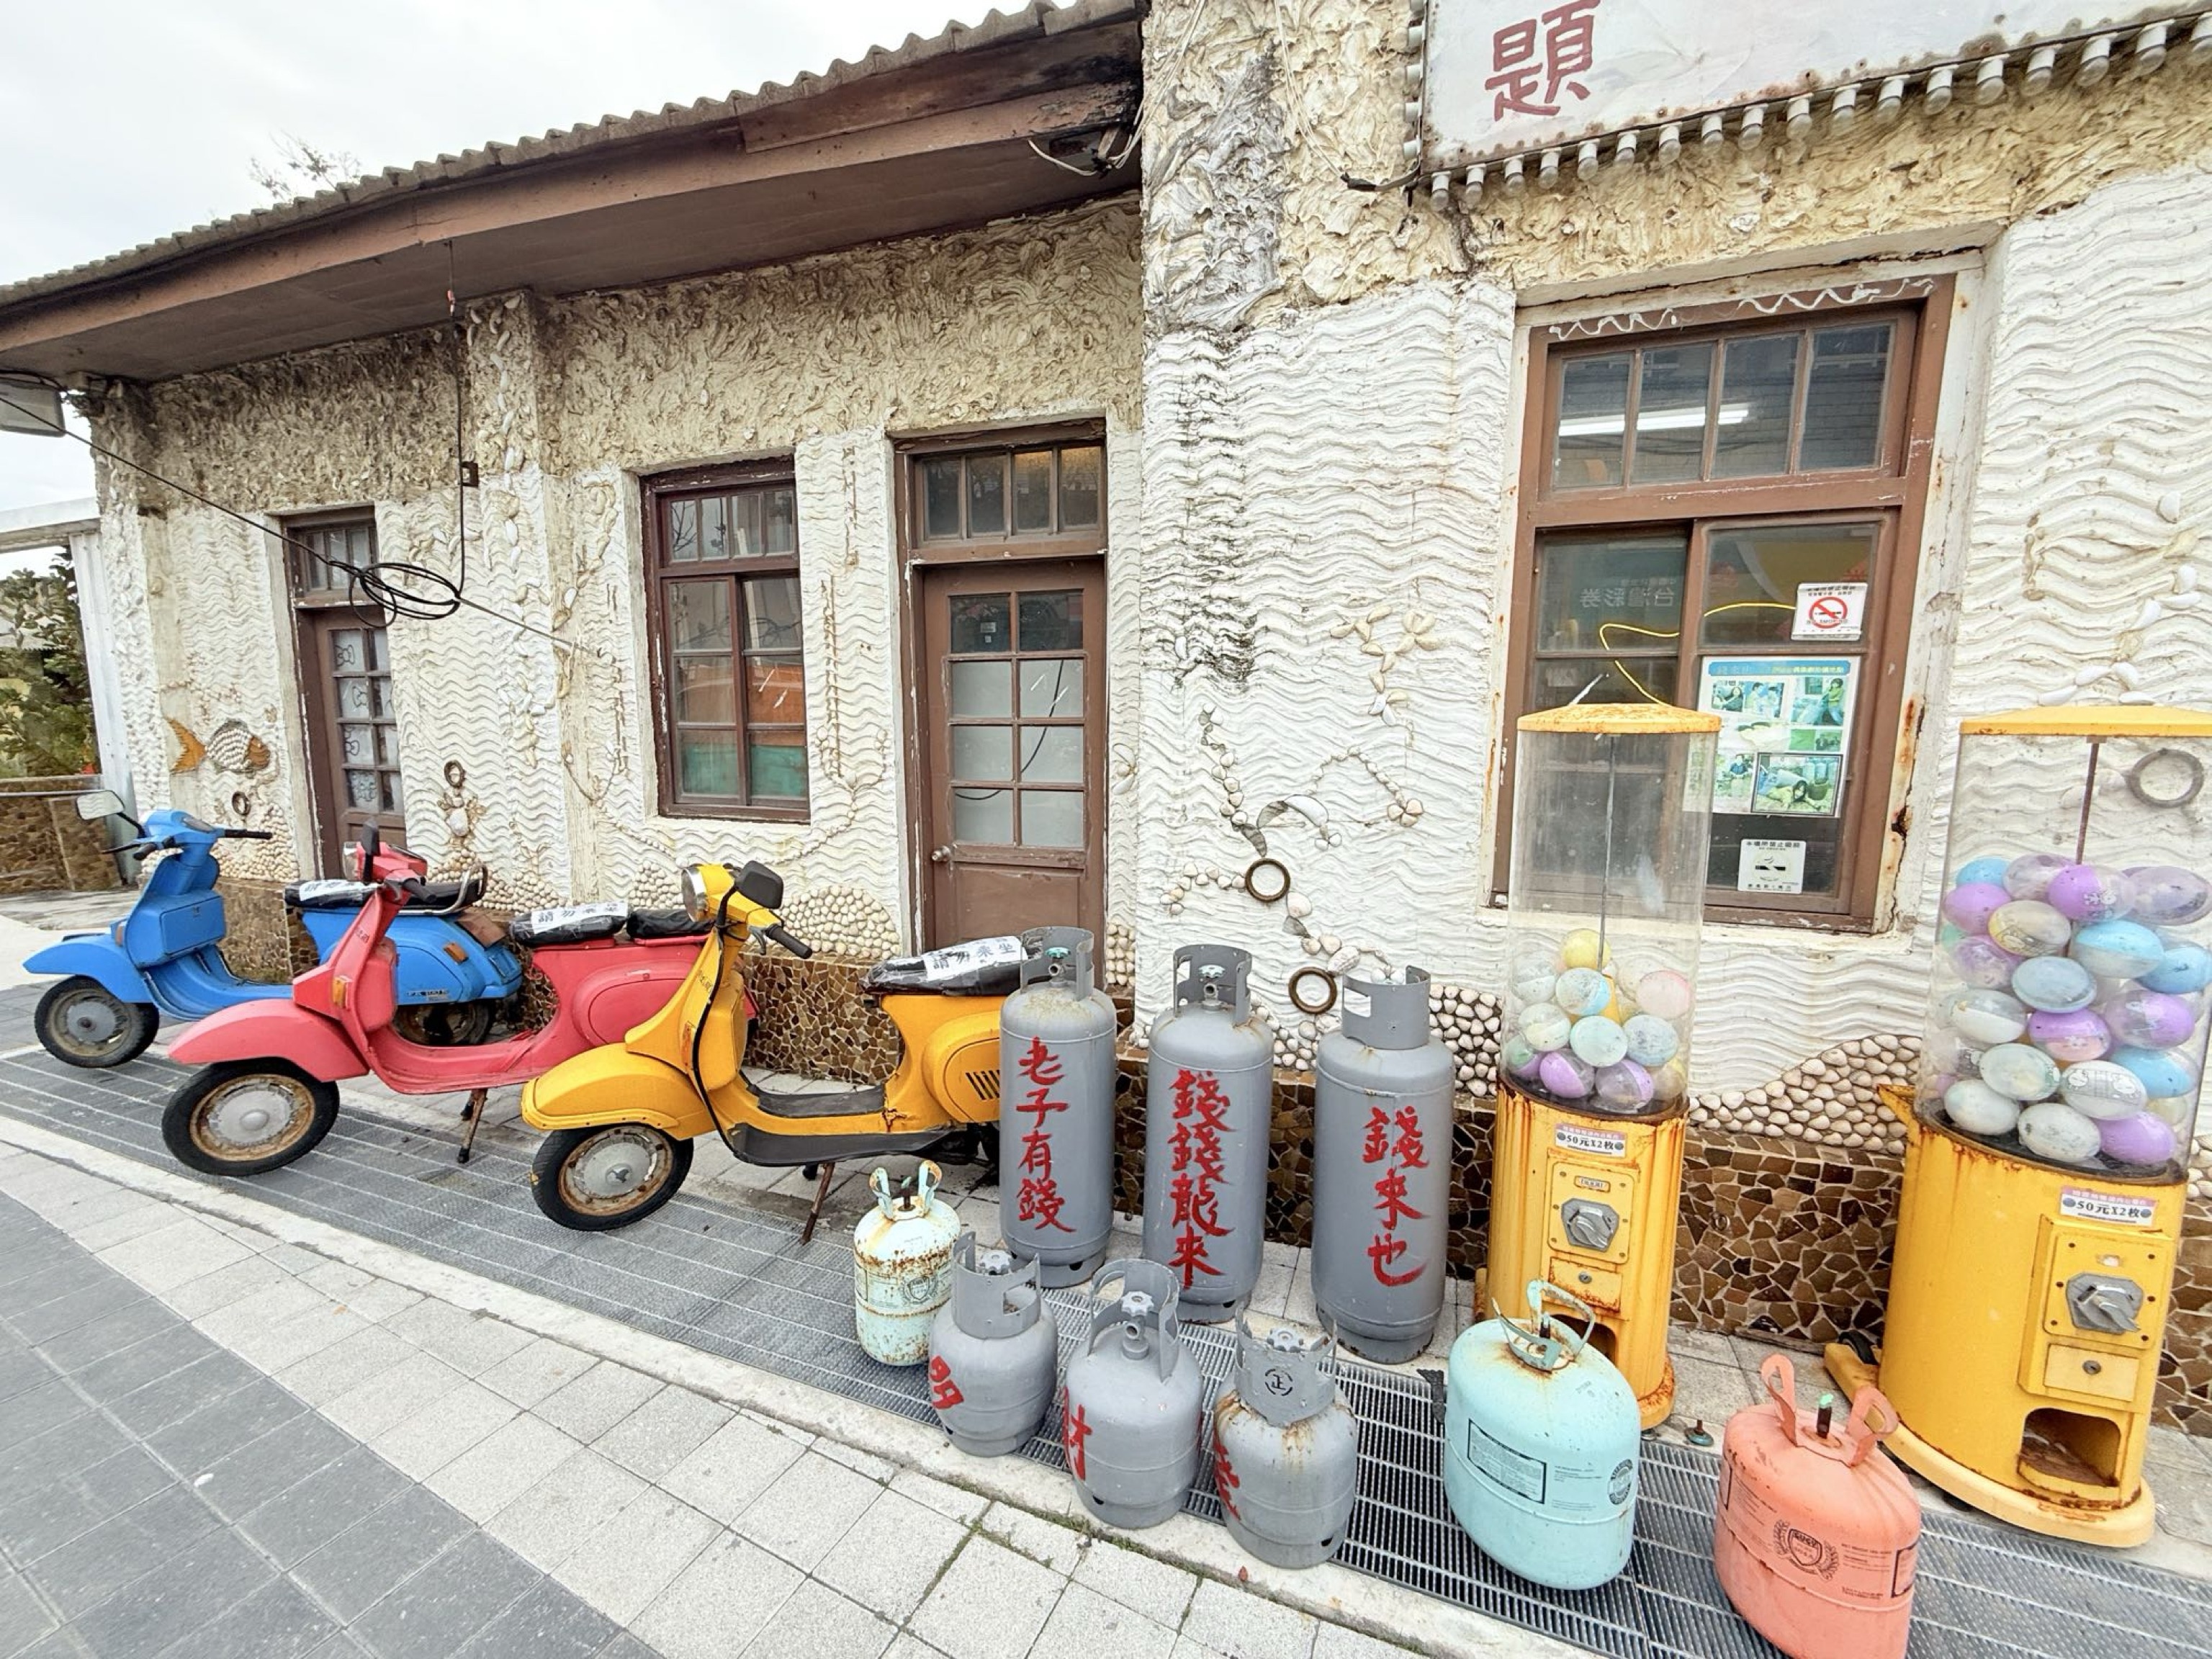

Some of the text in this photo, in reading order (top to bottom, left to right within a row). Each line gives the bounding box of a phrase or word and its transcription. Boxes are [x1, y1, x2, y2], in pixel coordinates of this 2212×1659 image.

[1485, 0, 1601, 121] 題
[1016, 1035, 1076, 1233] 老子有錢
[1362, 1105, 1431, 1287] 錢來也
